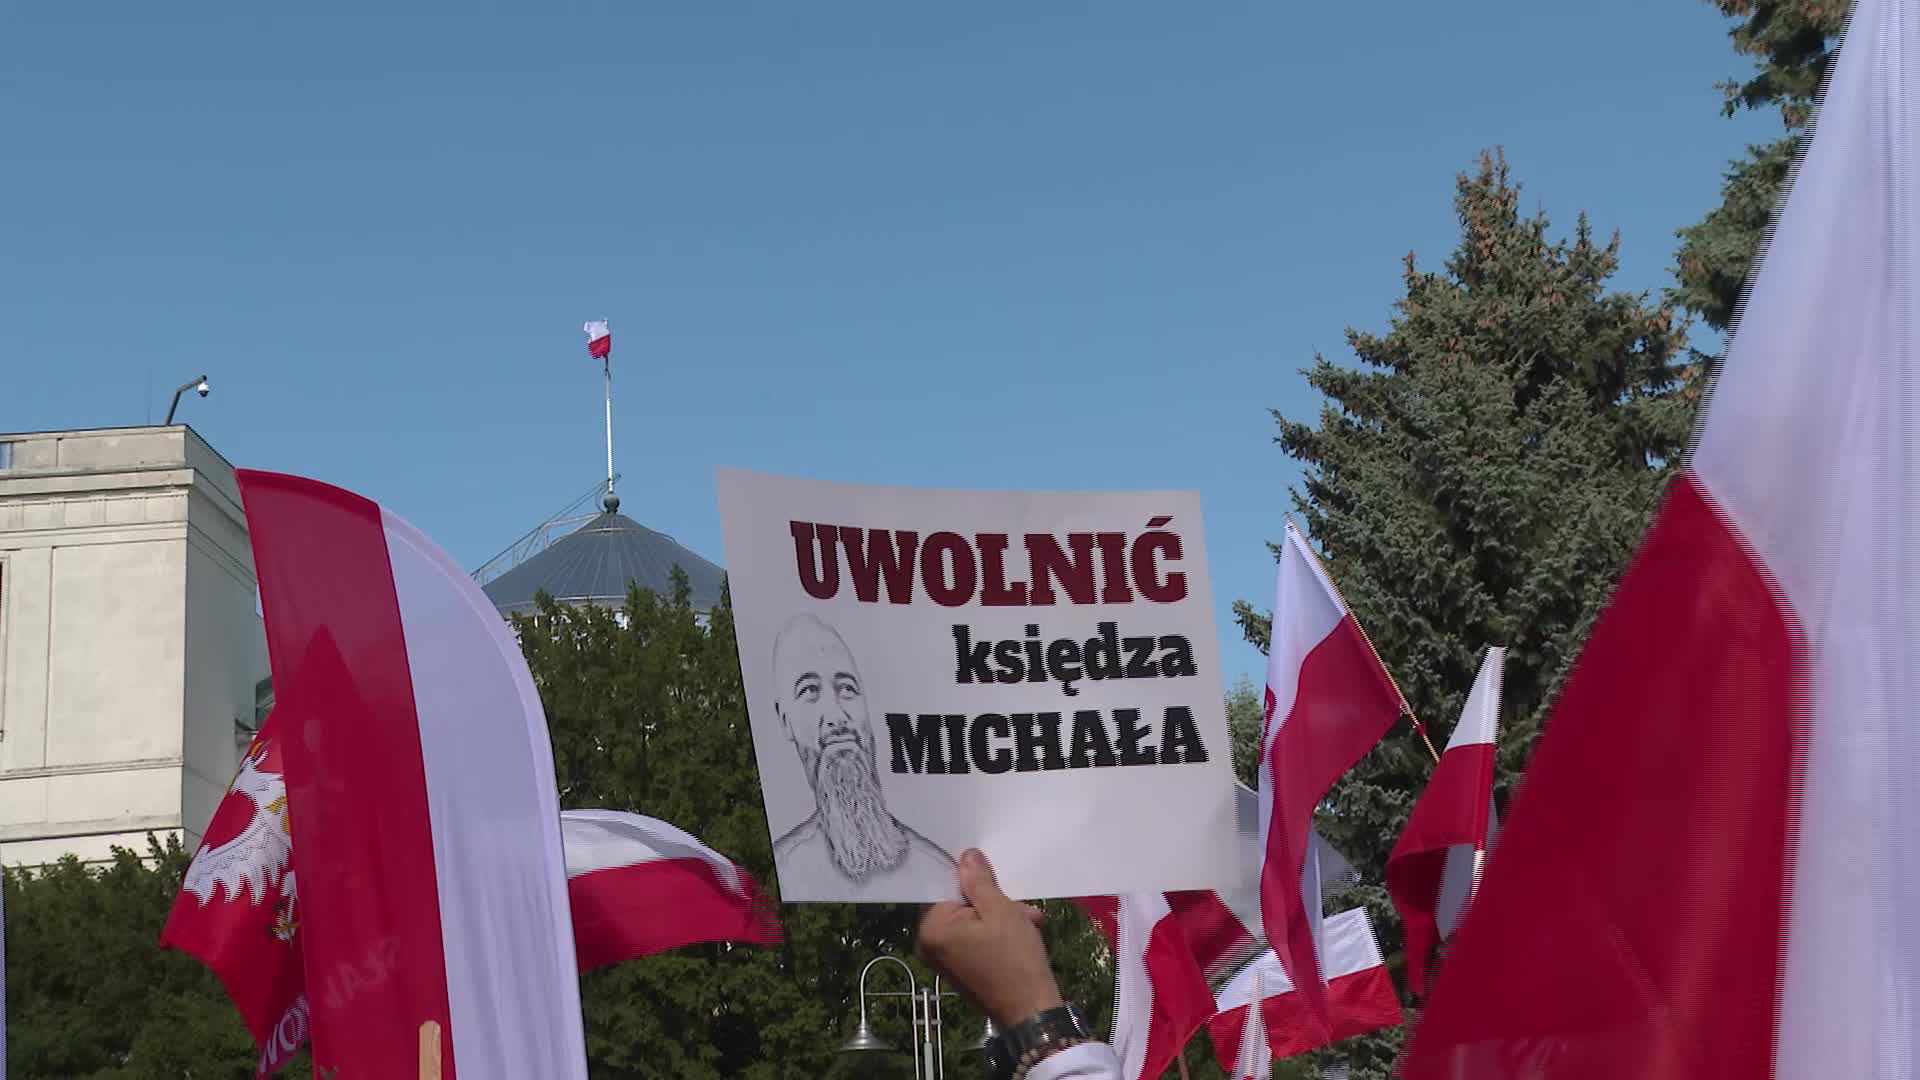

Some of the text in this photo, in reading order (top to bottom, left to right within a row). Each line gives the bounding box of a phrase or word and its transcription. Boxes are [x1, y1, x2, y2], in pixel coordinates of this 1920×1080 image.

[790, 516, 1188, 606] UWOLNIĆ
[952, 622, 1197, 696] księdza
[886, 706, 1209, 774] MICHAŁA
